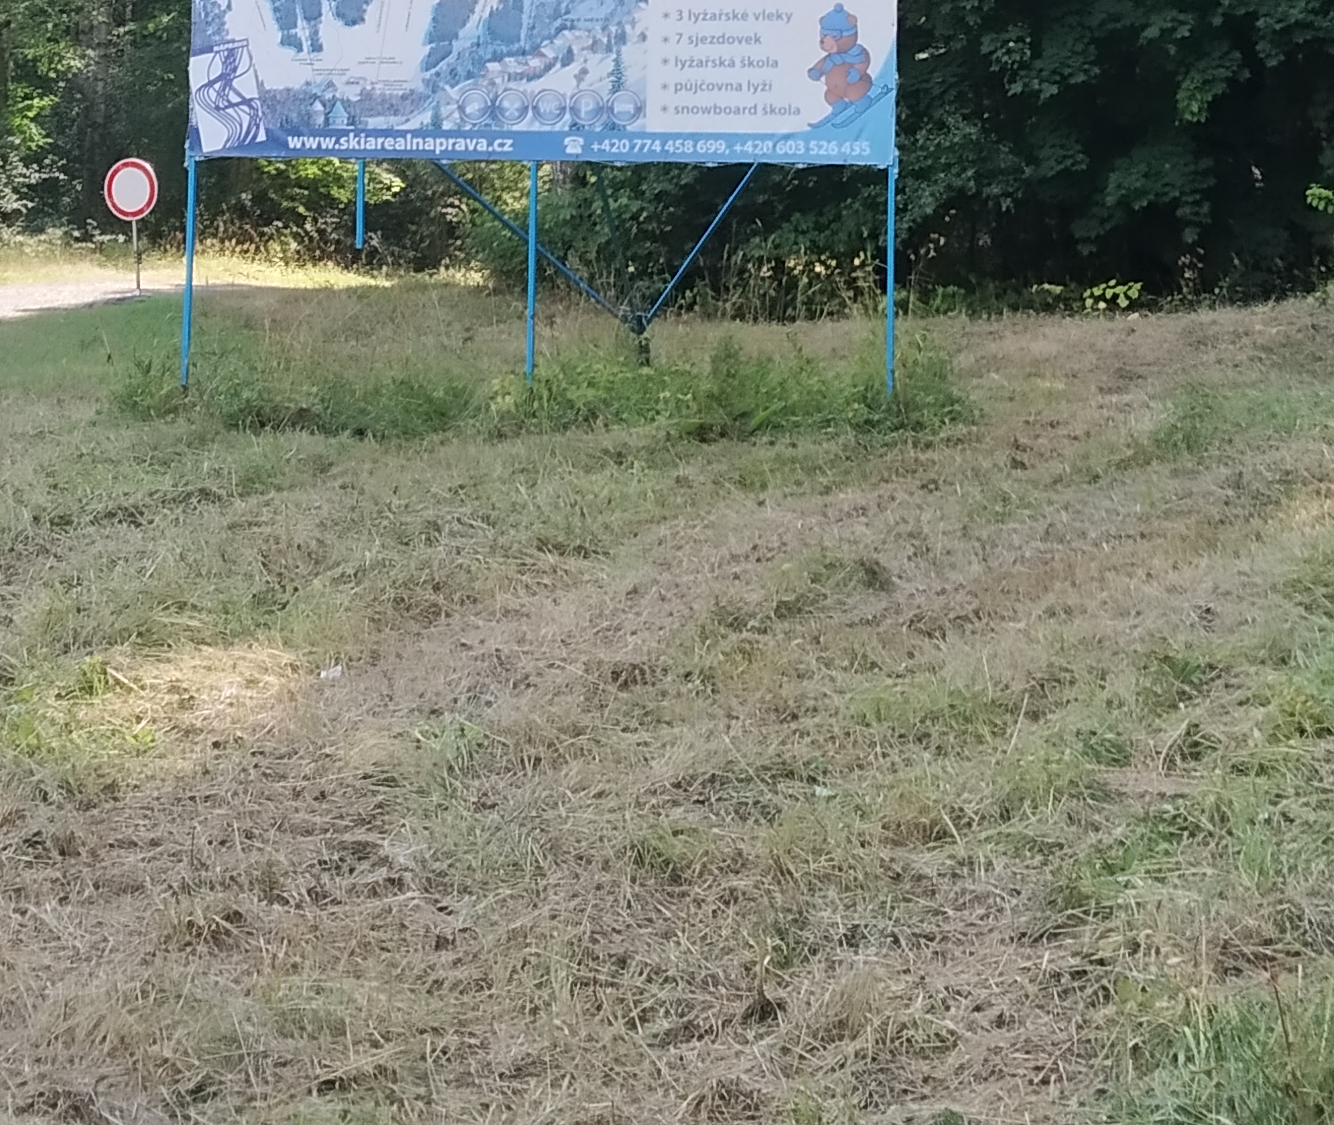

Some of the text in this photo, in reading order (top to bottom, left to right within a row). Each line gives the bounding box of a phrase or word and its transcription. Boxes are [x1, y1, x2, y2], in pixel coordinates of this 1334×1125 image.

[675, 9, 794, 24] 3 lyžařské vleky
[675, 32, 762, 48] 7 sjezdovek
[674, 56, 779, 71] lyžařská škola
[673, 79, 773, 94] půjčovna lyží
[538, 101, 560, 114] WC
[673, 103, 801, 116] snowboard škola
[287, 132, 514, 154] www.skiarealnaprava.cz
[591, 139, 870, 155] +420 774 458 699, +420 603 526 455
